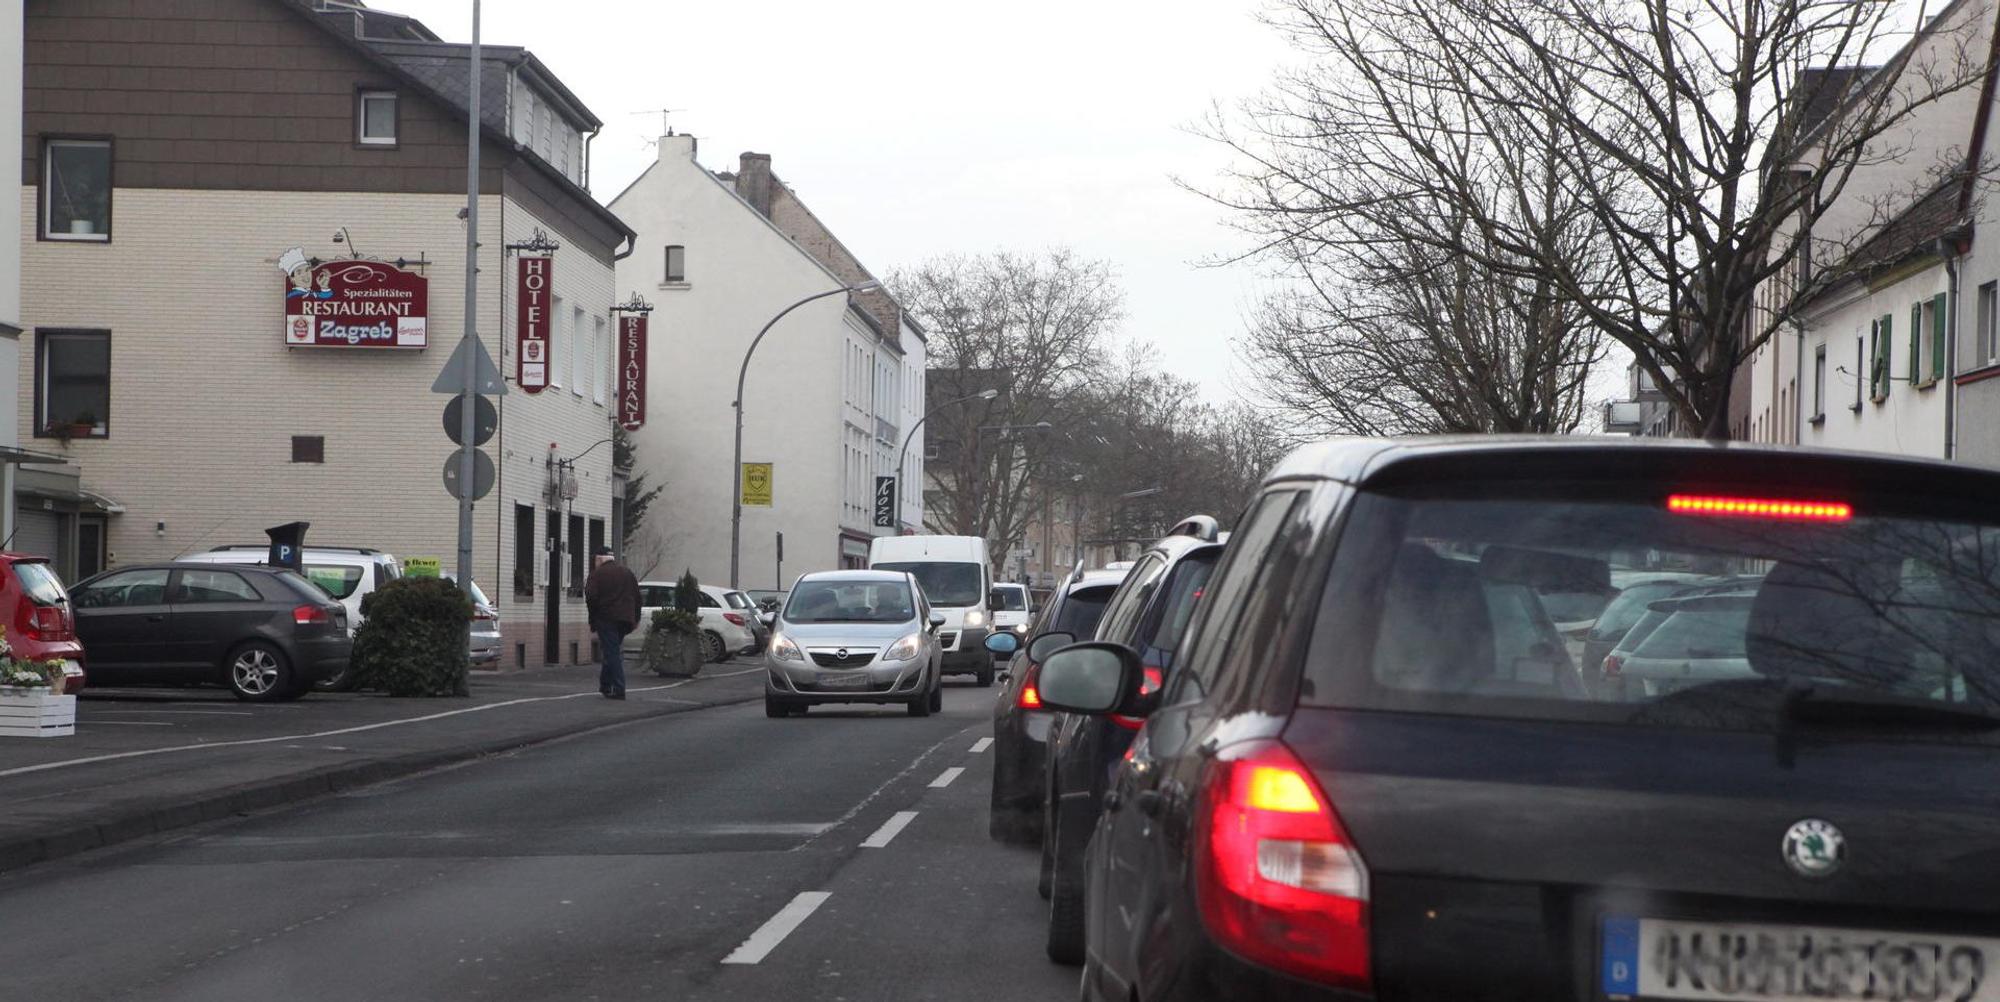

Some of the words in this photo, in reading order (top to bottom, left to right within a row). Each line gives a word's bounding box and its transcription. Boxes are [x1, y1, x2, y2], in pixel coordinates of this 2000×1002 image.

[343, 288, 413, 299] Spezialitäten
[525, 260, 544, 340] HOTEL
[302, 301, 412, 316] RESTAURANT
[319, 320, 393, 344] Zagreb
[625, 317, 639, 421] RESTAURANT
[280, 545, 291, 560] P
